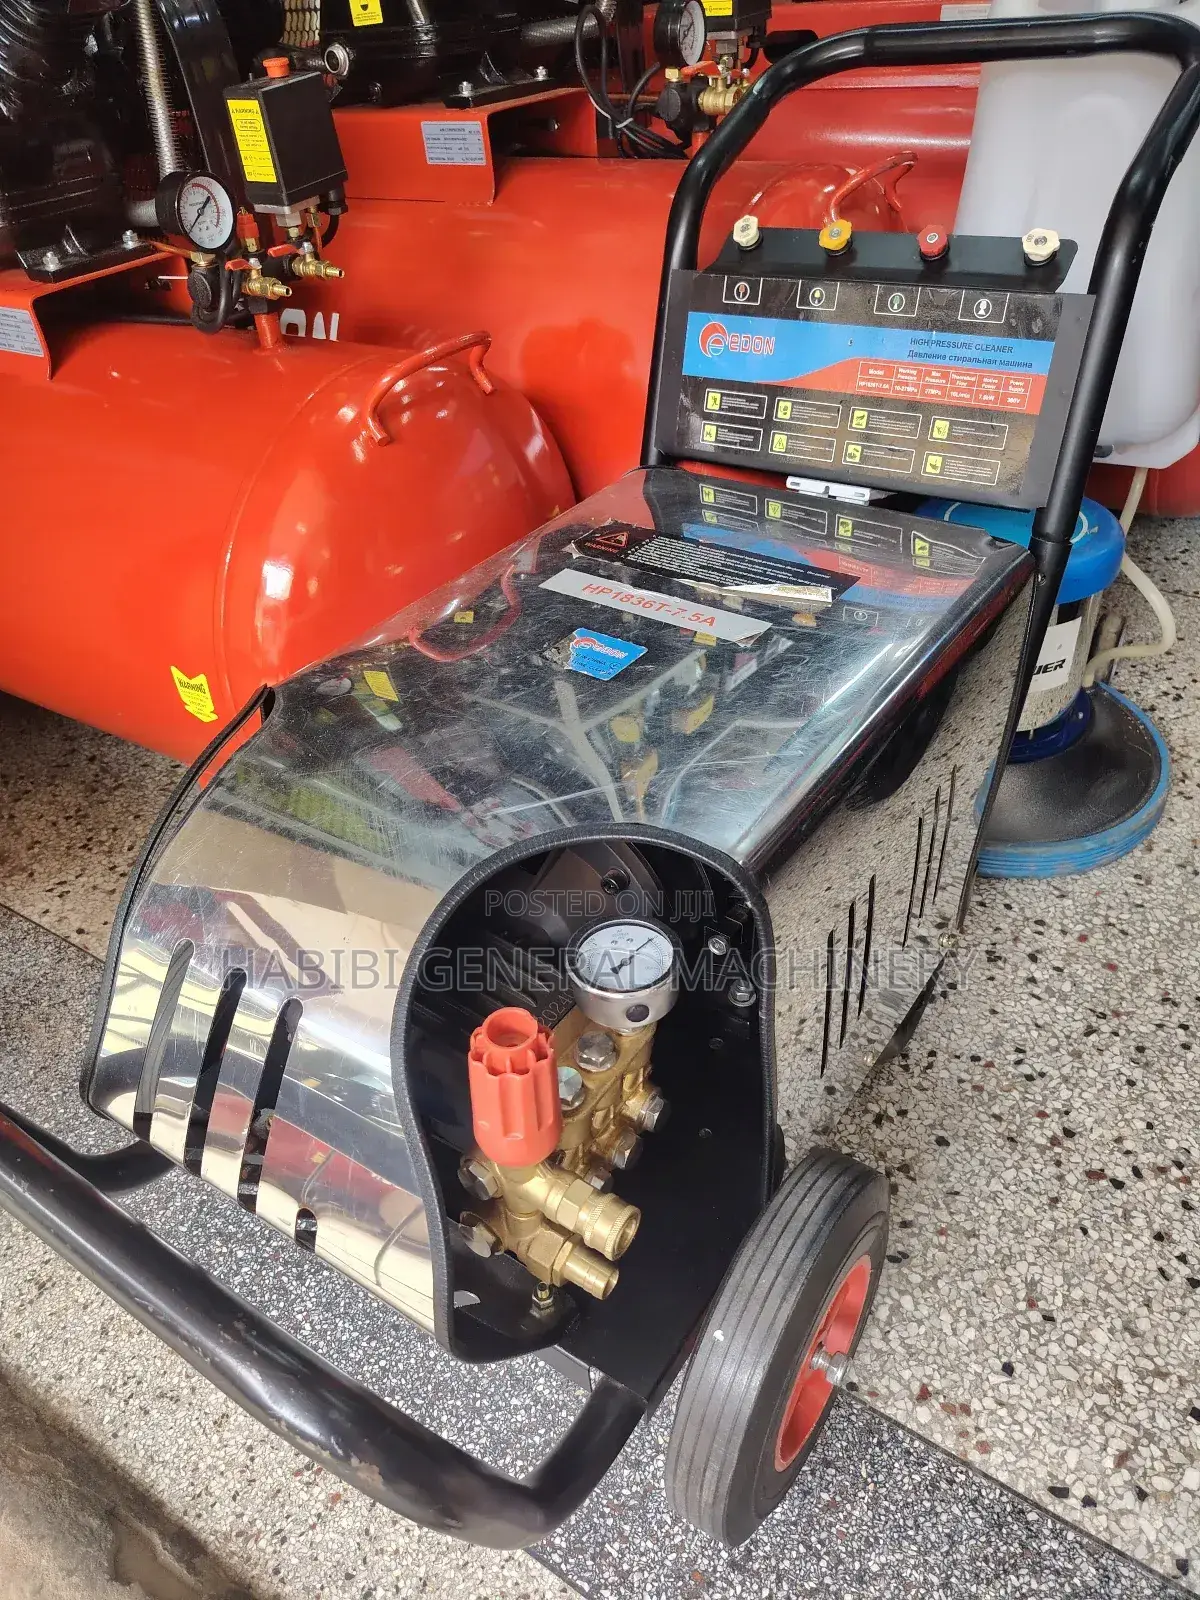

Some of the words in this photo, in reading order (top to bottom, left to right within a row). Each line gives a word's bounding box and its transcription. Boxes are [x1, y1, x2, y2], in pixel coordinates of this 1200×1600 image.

[910, 338, 929, 347] HIGH
[930, 340, 973, 351] PRESSURE
[974, 343, 1013, 354] CLEANER
[907, 349, 946, 361] Давление
[948, 355, 997, 366] стиральная
[999, 360, 1033, 369] машина
[868, 368, 885, 376] Model
[582, 583, 716, 627] HP1836T-7.5A
